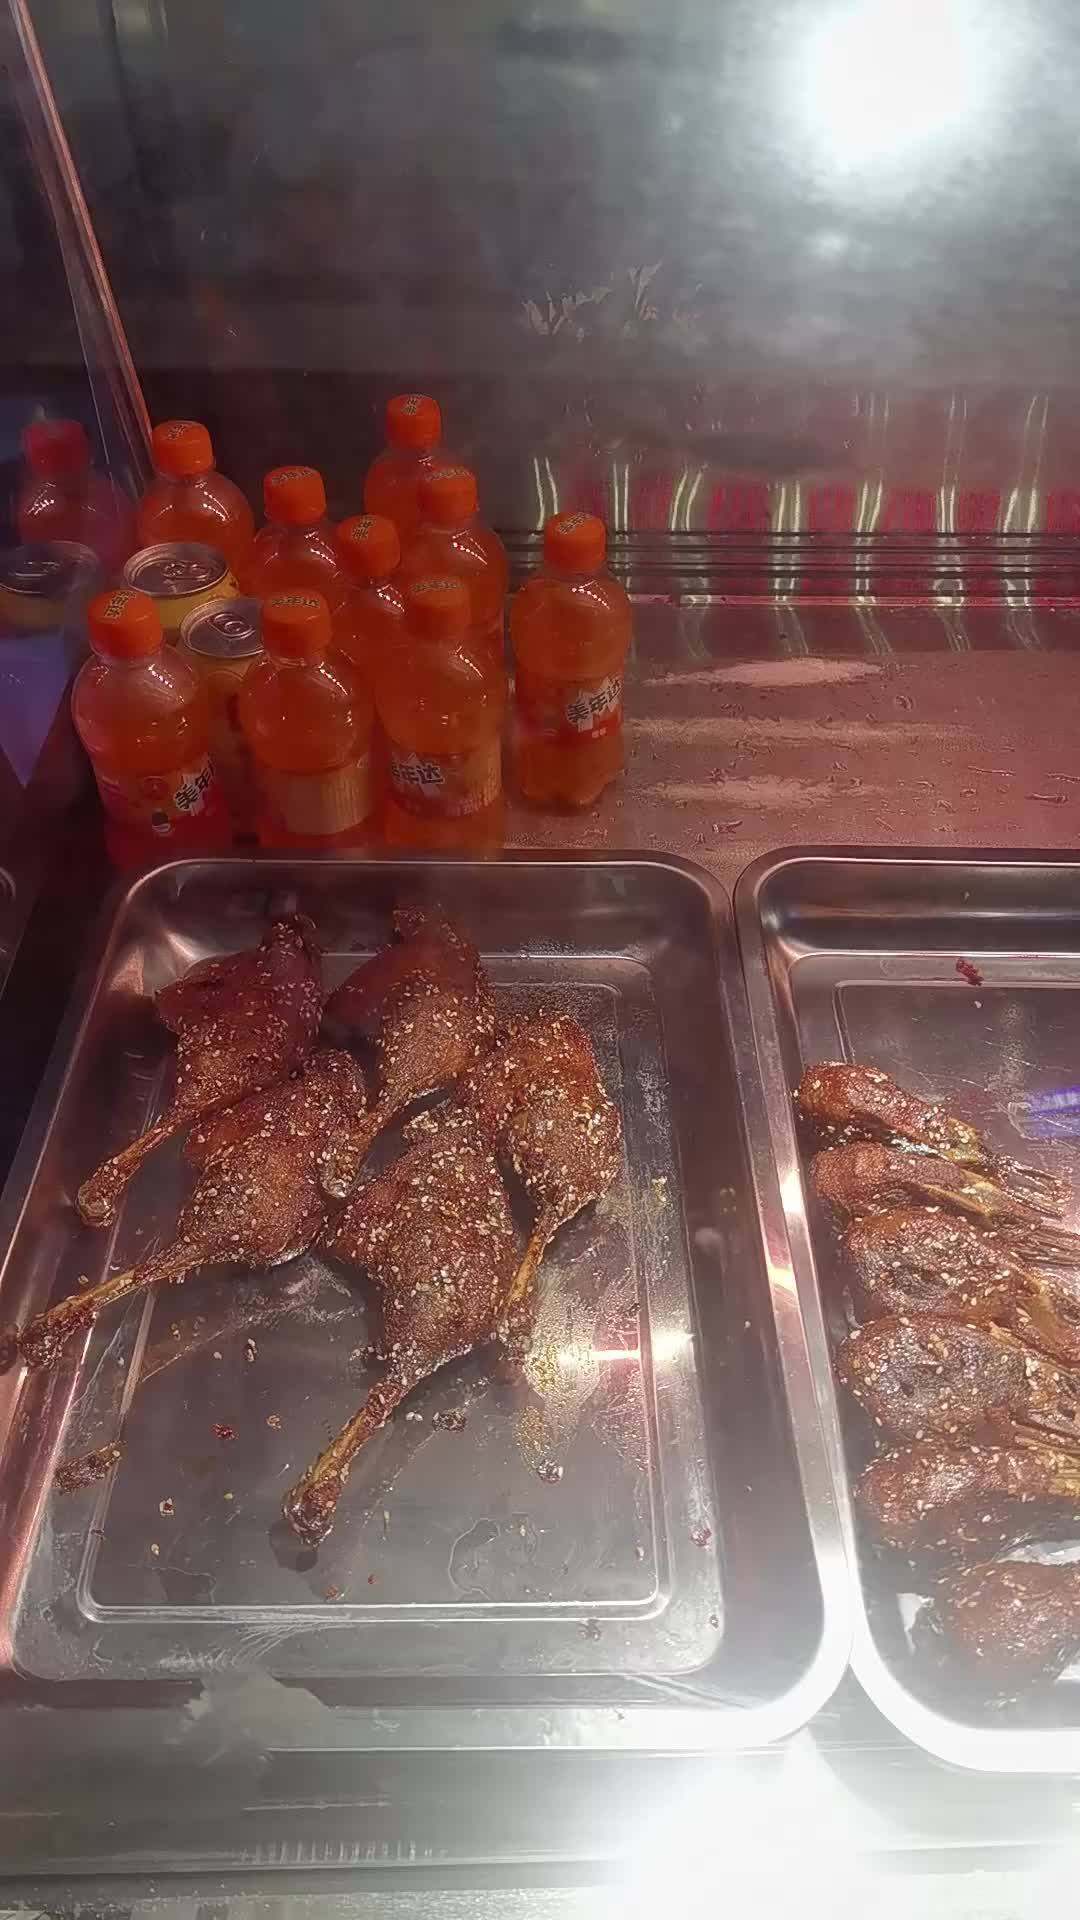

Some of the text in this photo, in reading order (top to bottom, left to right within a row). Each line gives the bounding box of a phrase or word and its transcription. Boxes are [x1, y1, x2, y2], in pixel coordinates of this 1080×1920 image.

[567, 677, 622, 723] 美年达
[175, 752, 215, 810] 美年
